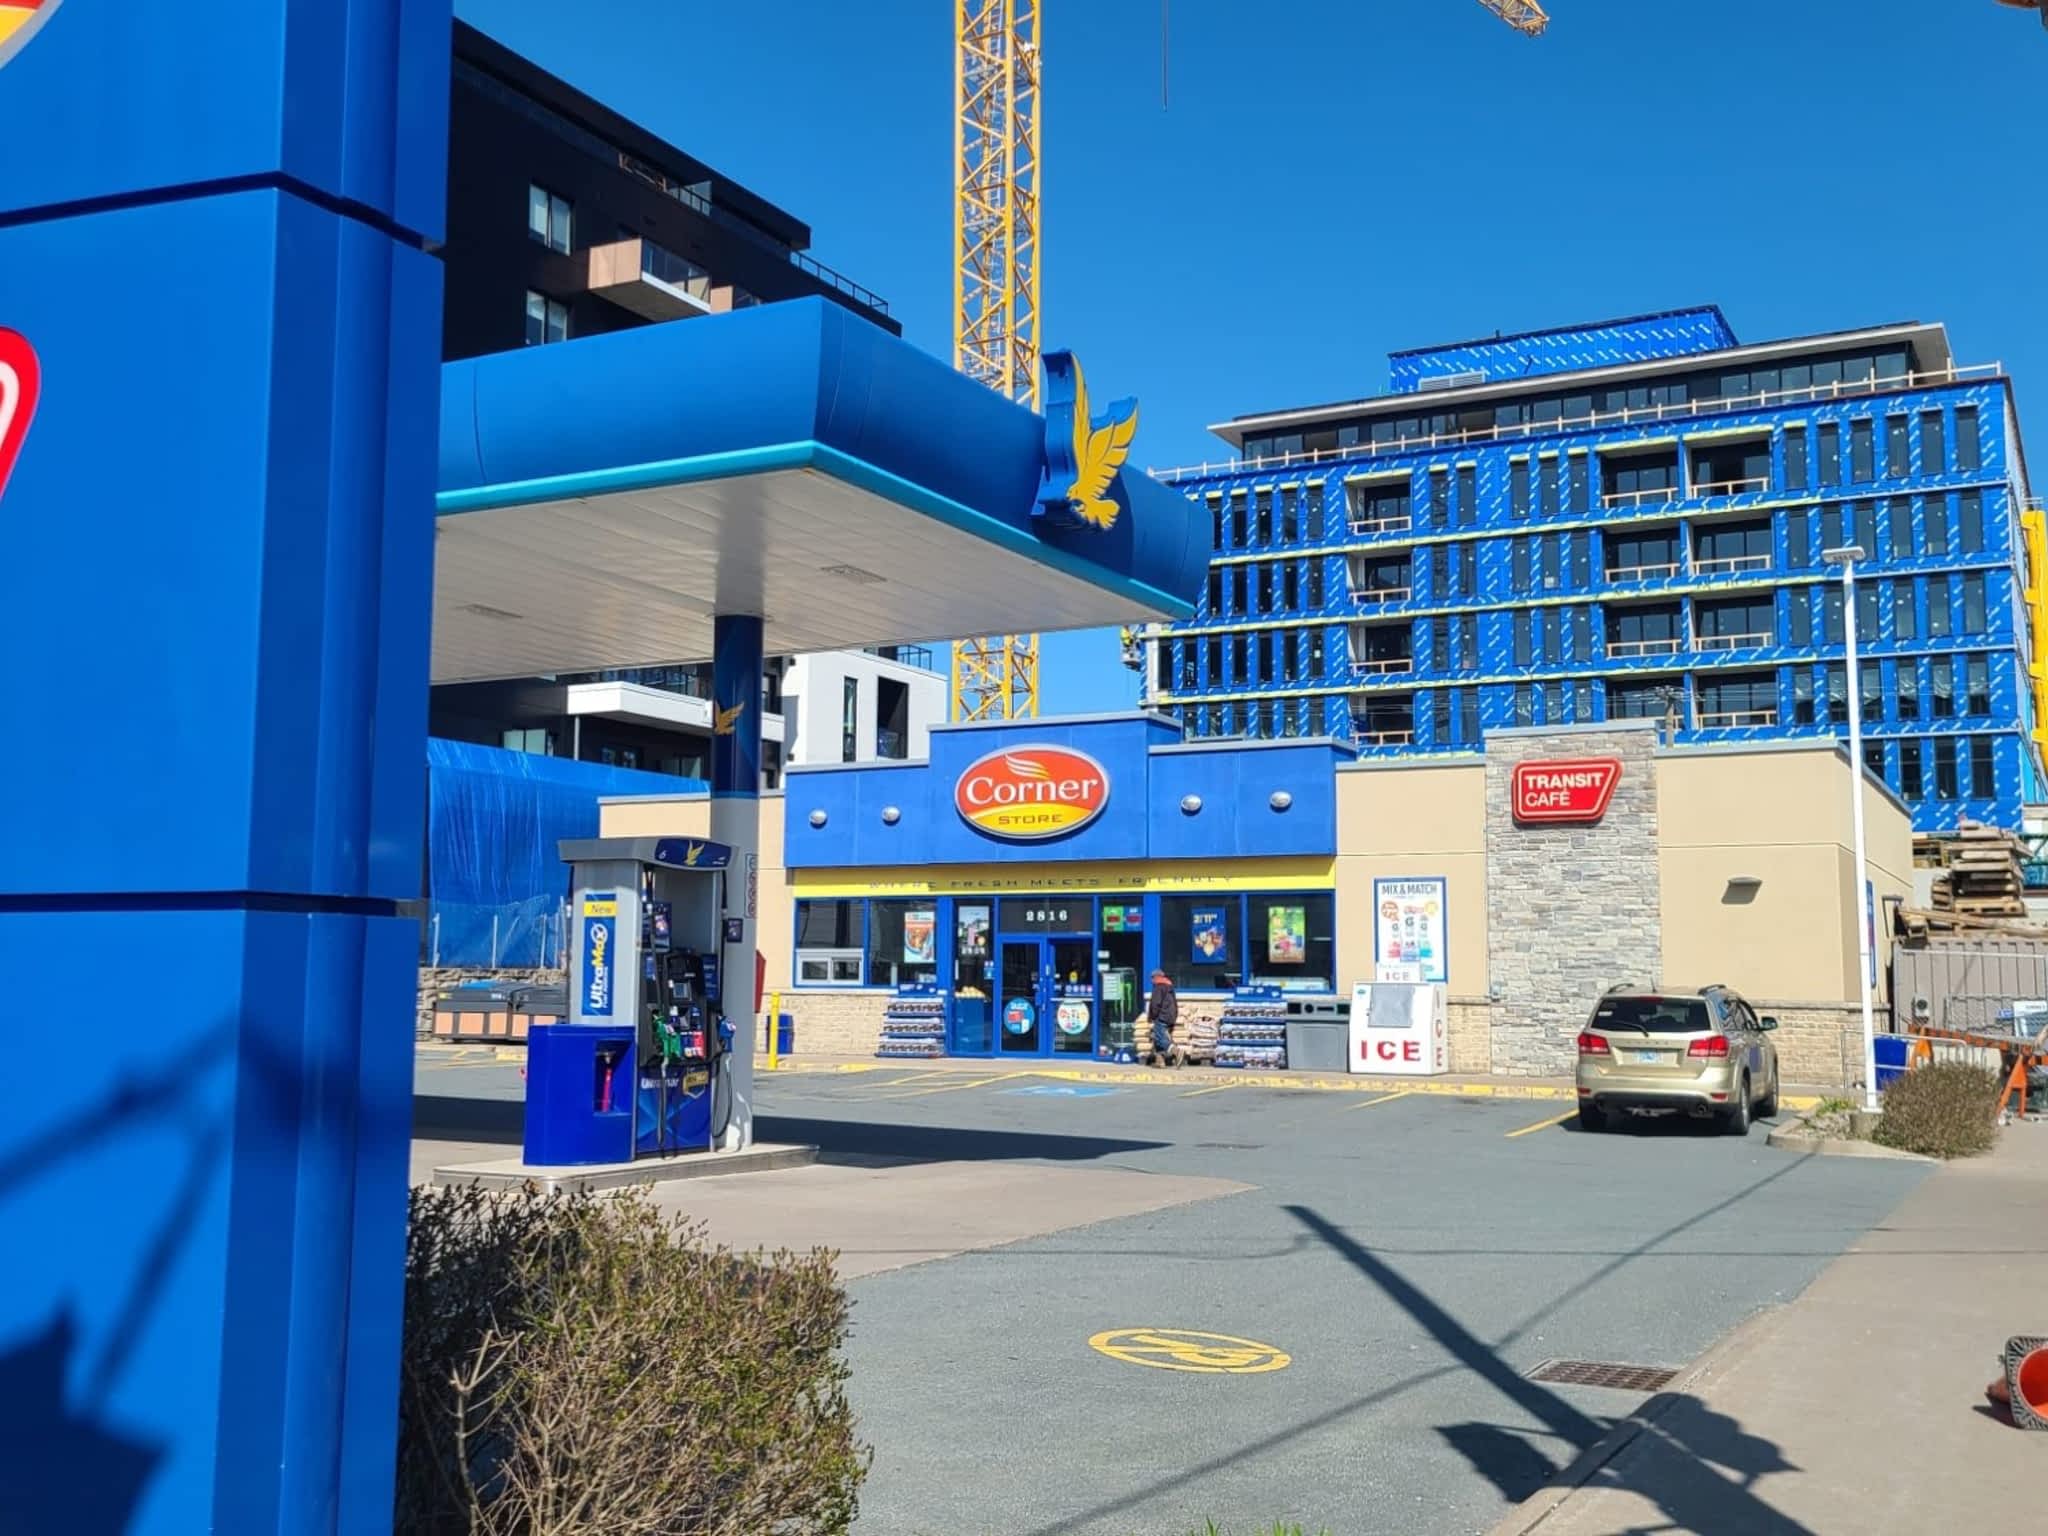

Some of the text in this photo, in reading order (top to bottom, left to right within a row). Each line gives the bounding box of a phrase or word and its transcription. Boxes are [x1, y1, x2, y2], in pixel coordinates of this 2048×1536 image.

[1525, 772, 1604, 789] TRANSIT
[966, 777, 1098, 804] Corner
[1525, 788, 1571, 807] CAFÉ
[998, 814, 1062, 825] STORE
[1382, 885, 1398, 895] MIX
[1408, 884, 1437, 894] MATCH
[1026, 910, 1068, 921] 2816
[1386, 971, 1409, 980] ICE
[1361, 1040, 1420, 1061] ICE
